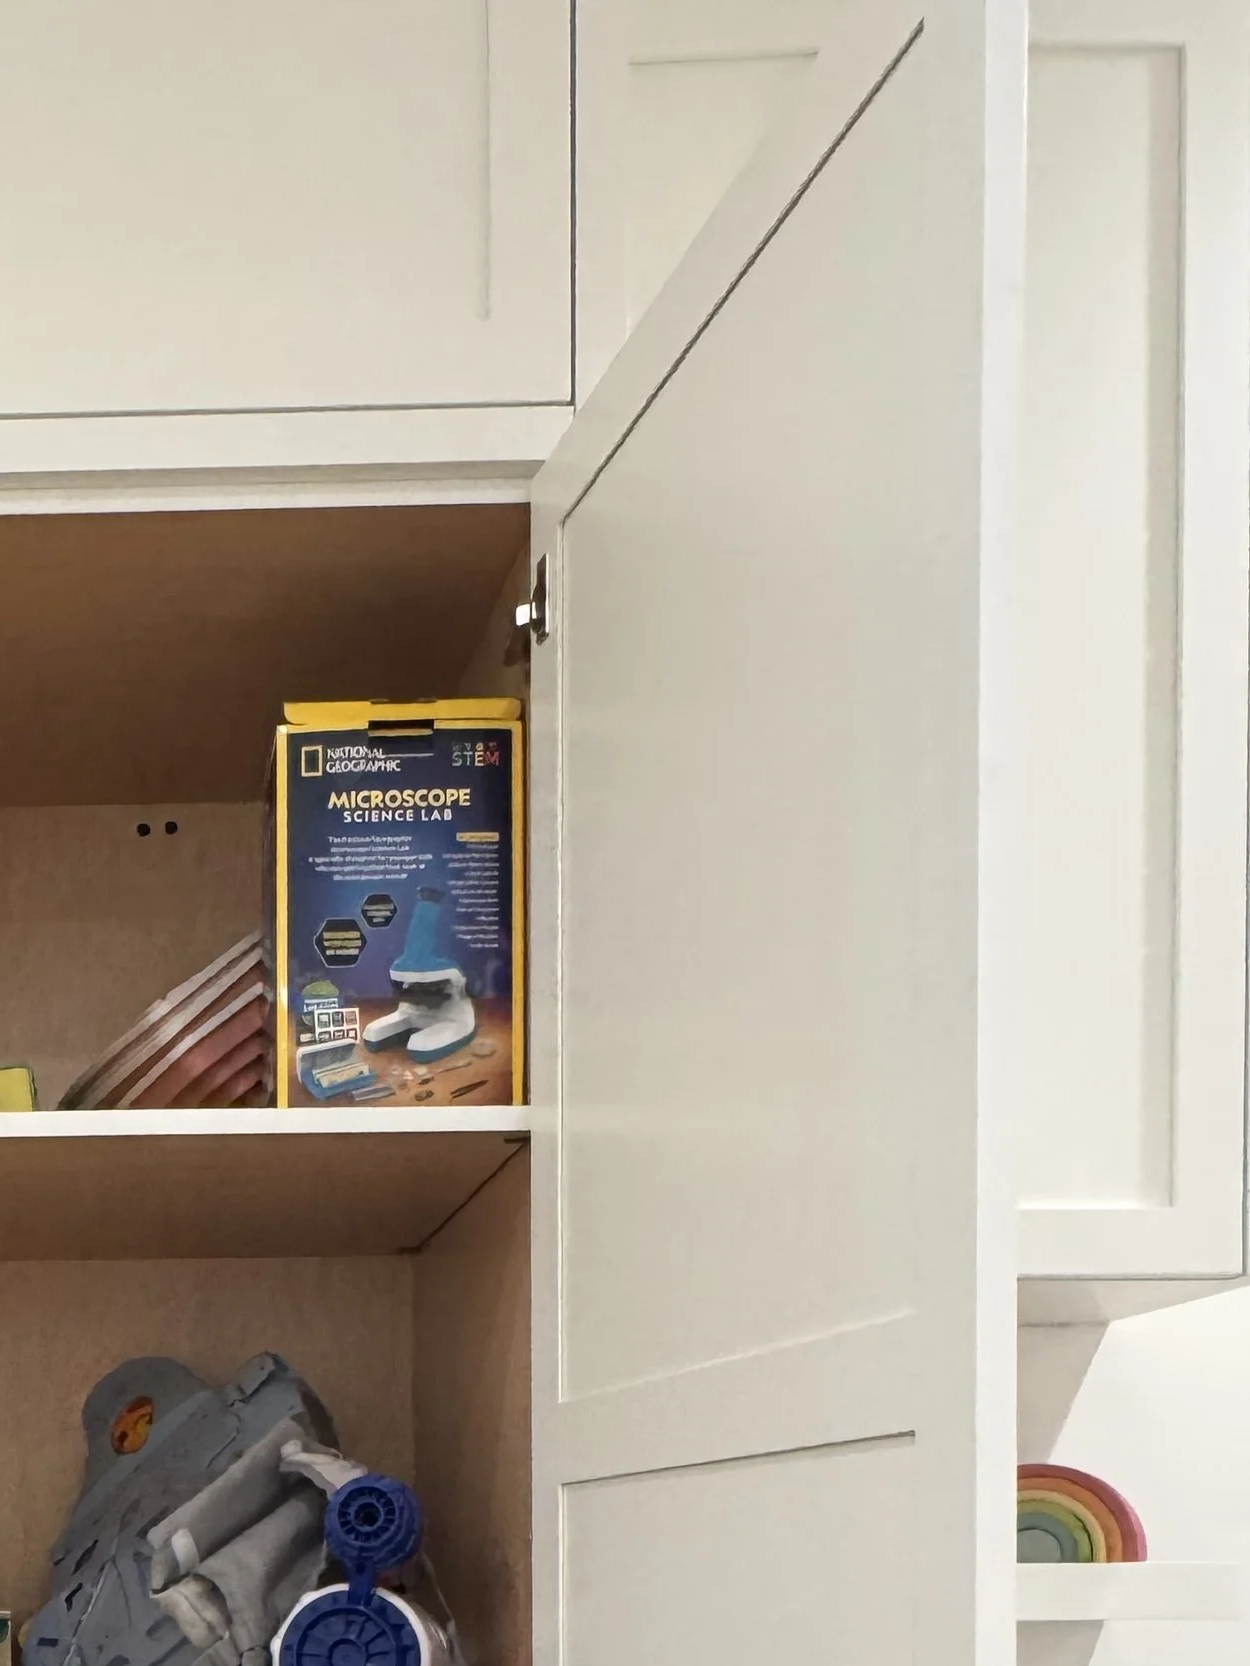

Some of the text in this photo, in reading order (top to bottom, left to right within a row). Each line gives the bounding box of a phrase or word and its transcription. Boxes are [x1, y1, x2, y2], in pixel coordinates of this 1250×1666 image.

[327, 746, 385, 760] NATIONAL
[452, 751, 500, 767] STEM
[326, 759, 402, 774] GEOGRAPHIC
[327, 788, 471, 810] MICROSCOPE
[343, 808, 453, 823] SCIENCE LAB
